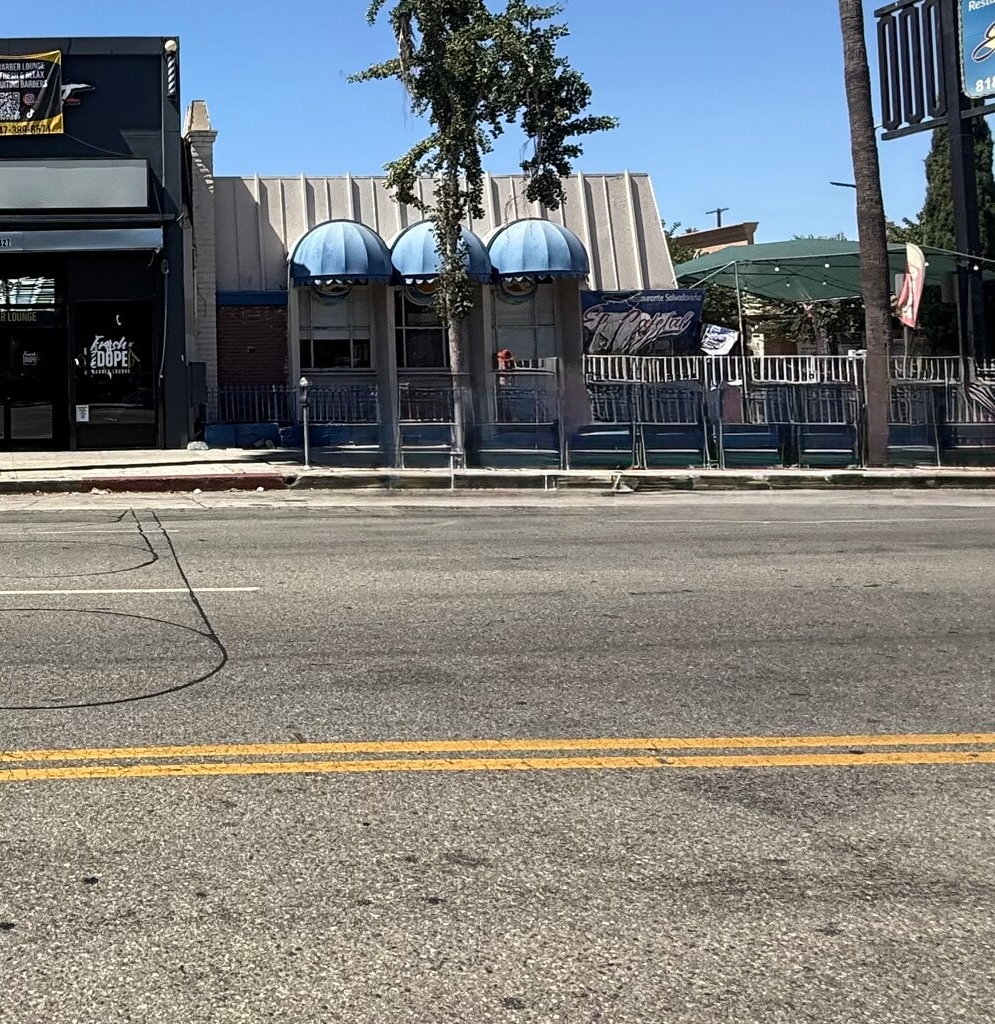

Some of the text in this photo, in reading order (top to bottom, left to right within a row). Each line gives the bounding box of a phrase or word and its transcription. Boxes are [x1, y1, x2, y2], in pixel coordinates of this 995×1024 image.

[22, 61, 45, 70] LOUNGE
[20, 79, 48, 88] BARBERS
[7, 312, 38, 322] LOUNGE
[89, 334, 128, 352] Fresh
[96, 350, 128, 368] DOPE
